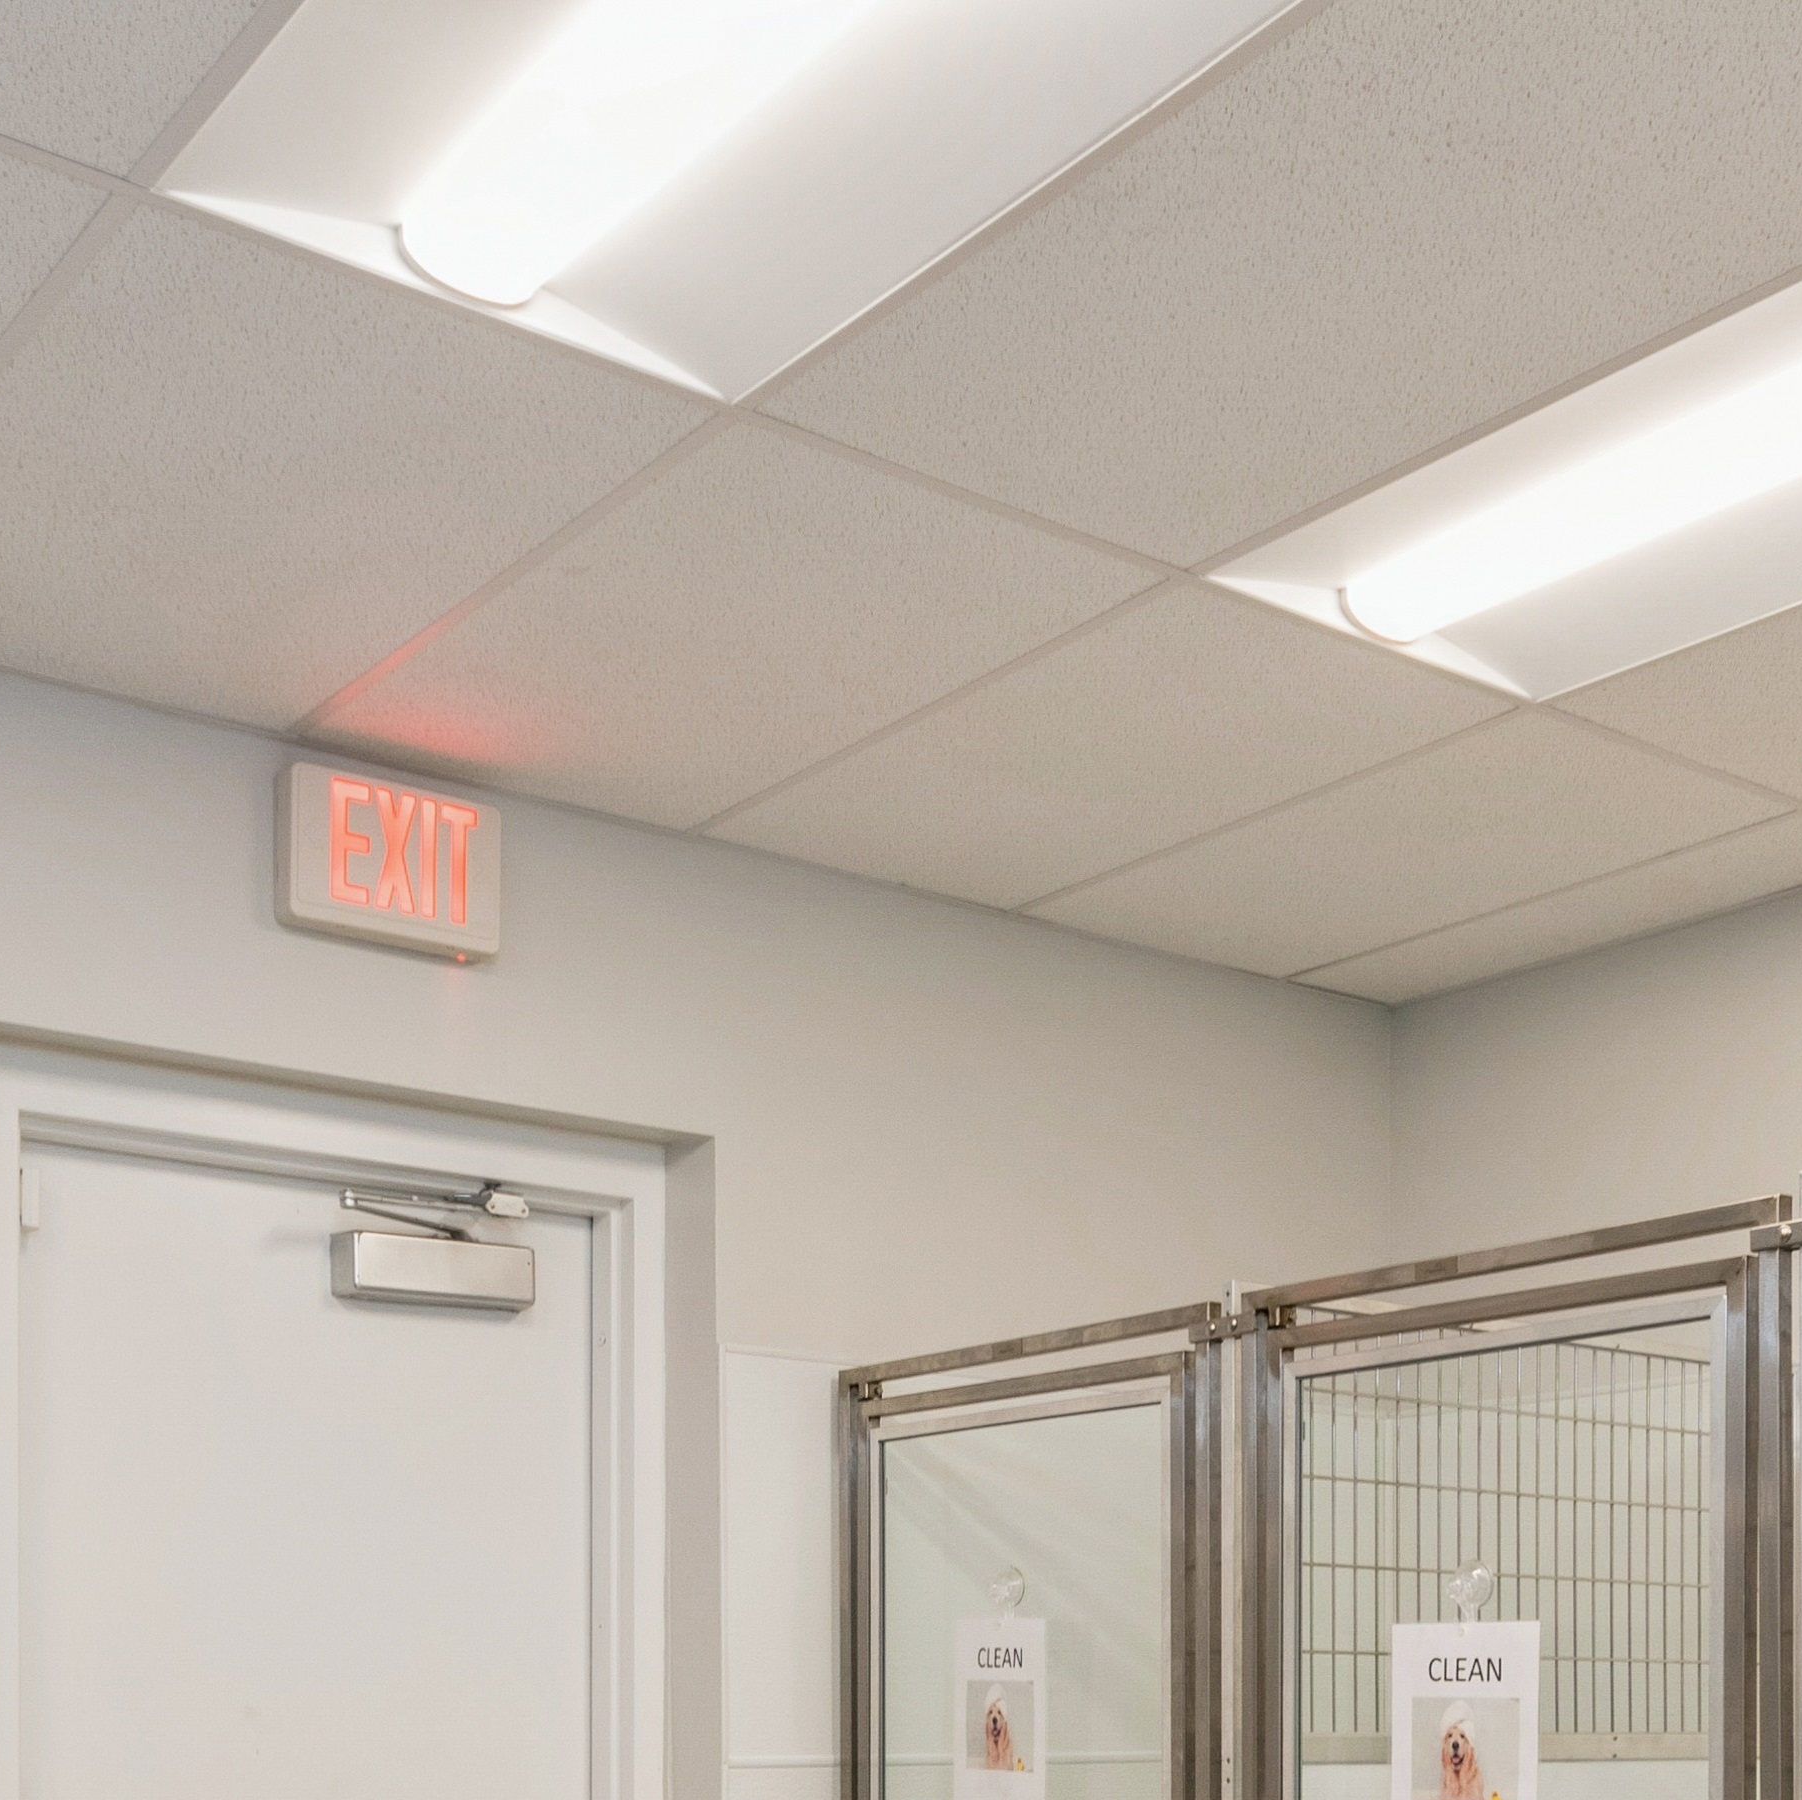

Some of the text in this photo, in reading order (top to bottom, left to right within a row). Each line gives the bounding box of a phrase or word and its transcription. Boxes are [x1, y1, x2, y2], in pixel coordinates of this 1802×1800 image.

[329, 775, 479, 926] EXIT
[977, 1647, 1023, 1669] CLEAN
[1428, 1657, 1503, 1683] CLEAN
